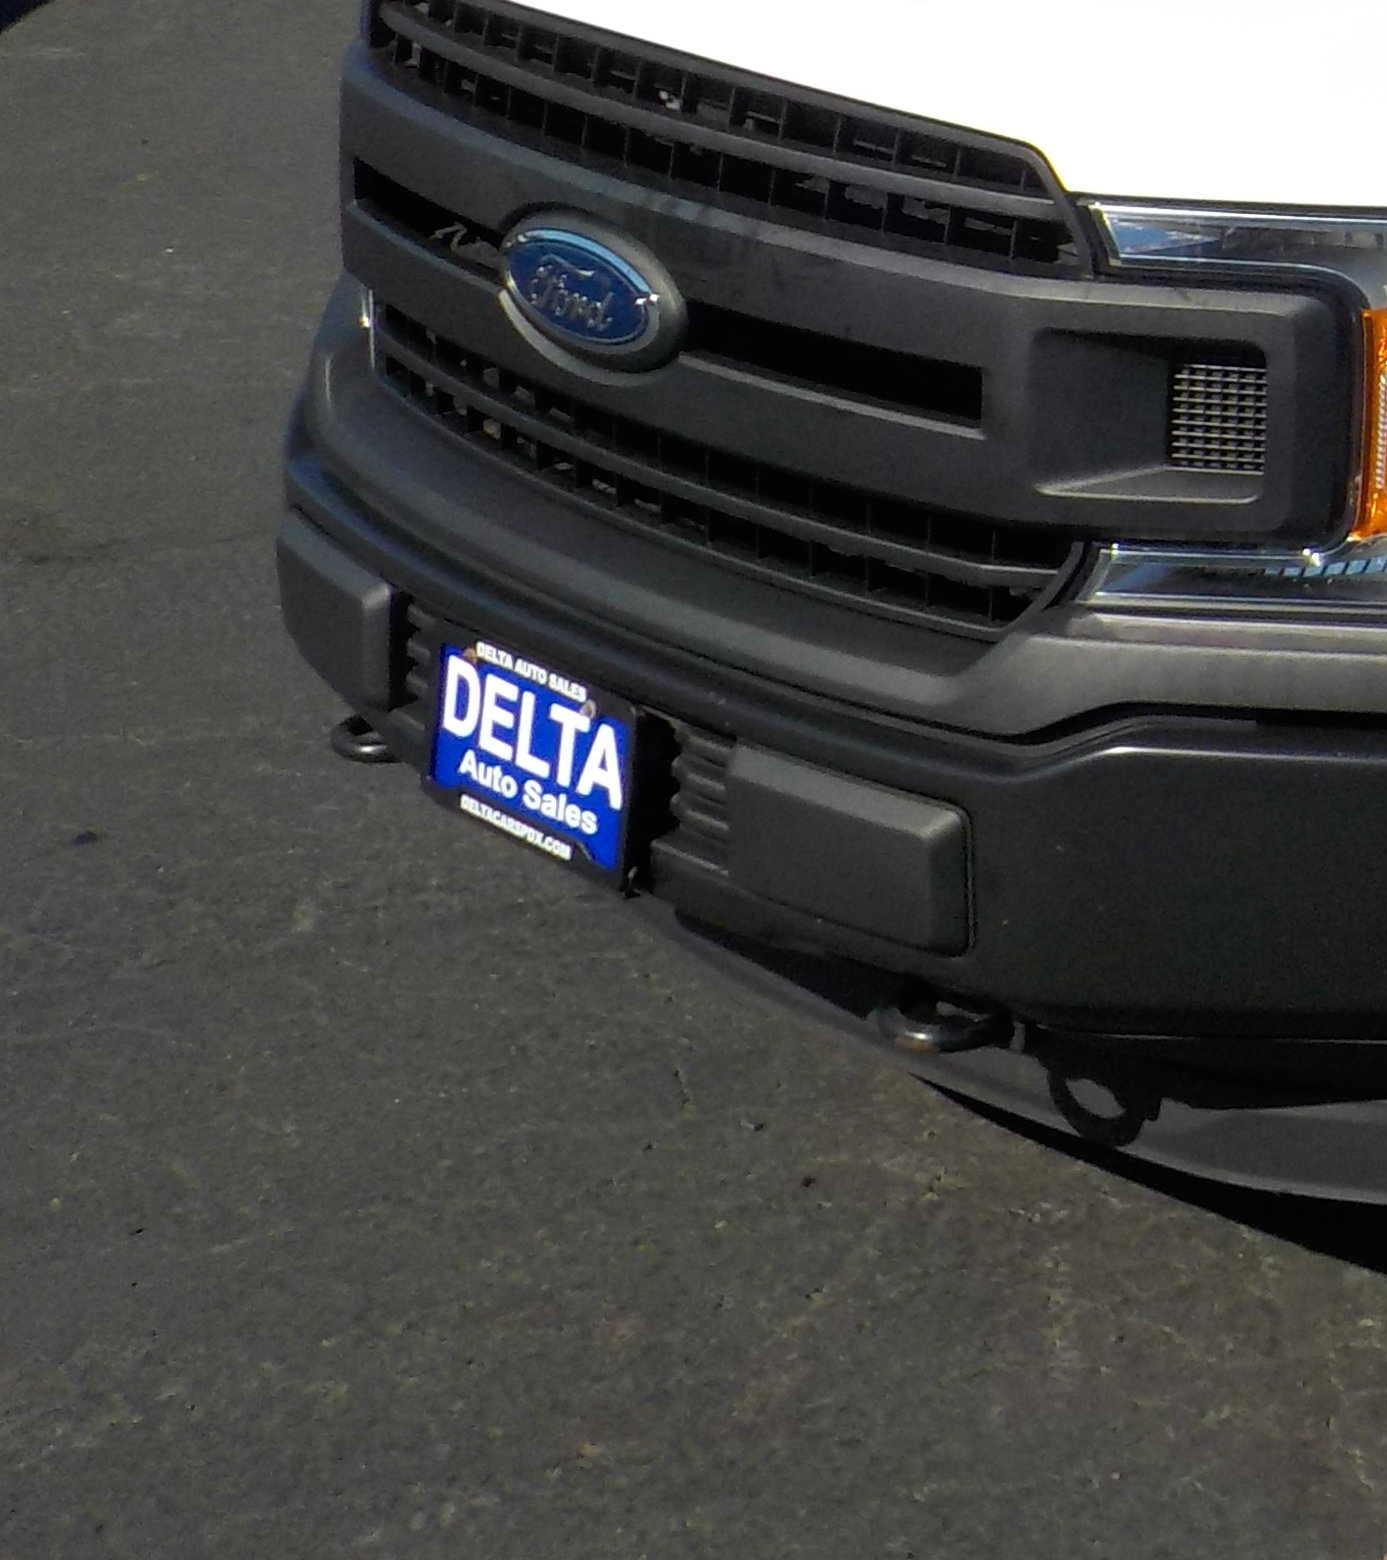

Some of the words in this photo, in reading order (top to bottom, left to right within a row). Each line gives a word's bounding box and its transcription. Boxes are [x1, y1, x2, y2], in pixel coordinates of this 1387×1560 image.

[527, 253, 615, 332] Ford
[476, 641, 513, 670] DELTA
[514, 658, 547, 685] AUTO
[549, 673, 587, 703] SALES
[441, 654, 623, 811] DELTA
[458, 749, 519, 800] Auto
[522, 779, 598, 836] Sales
